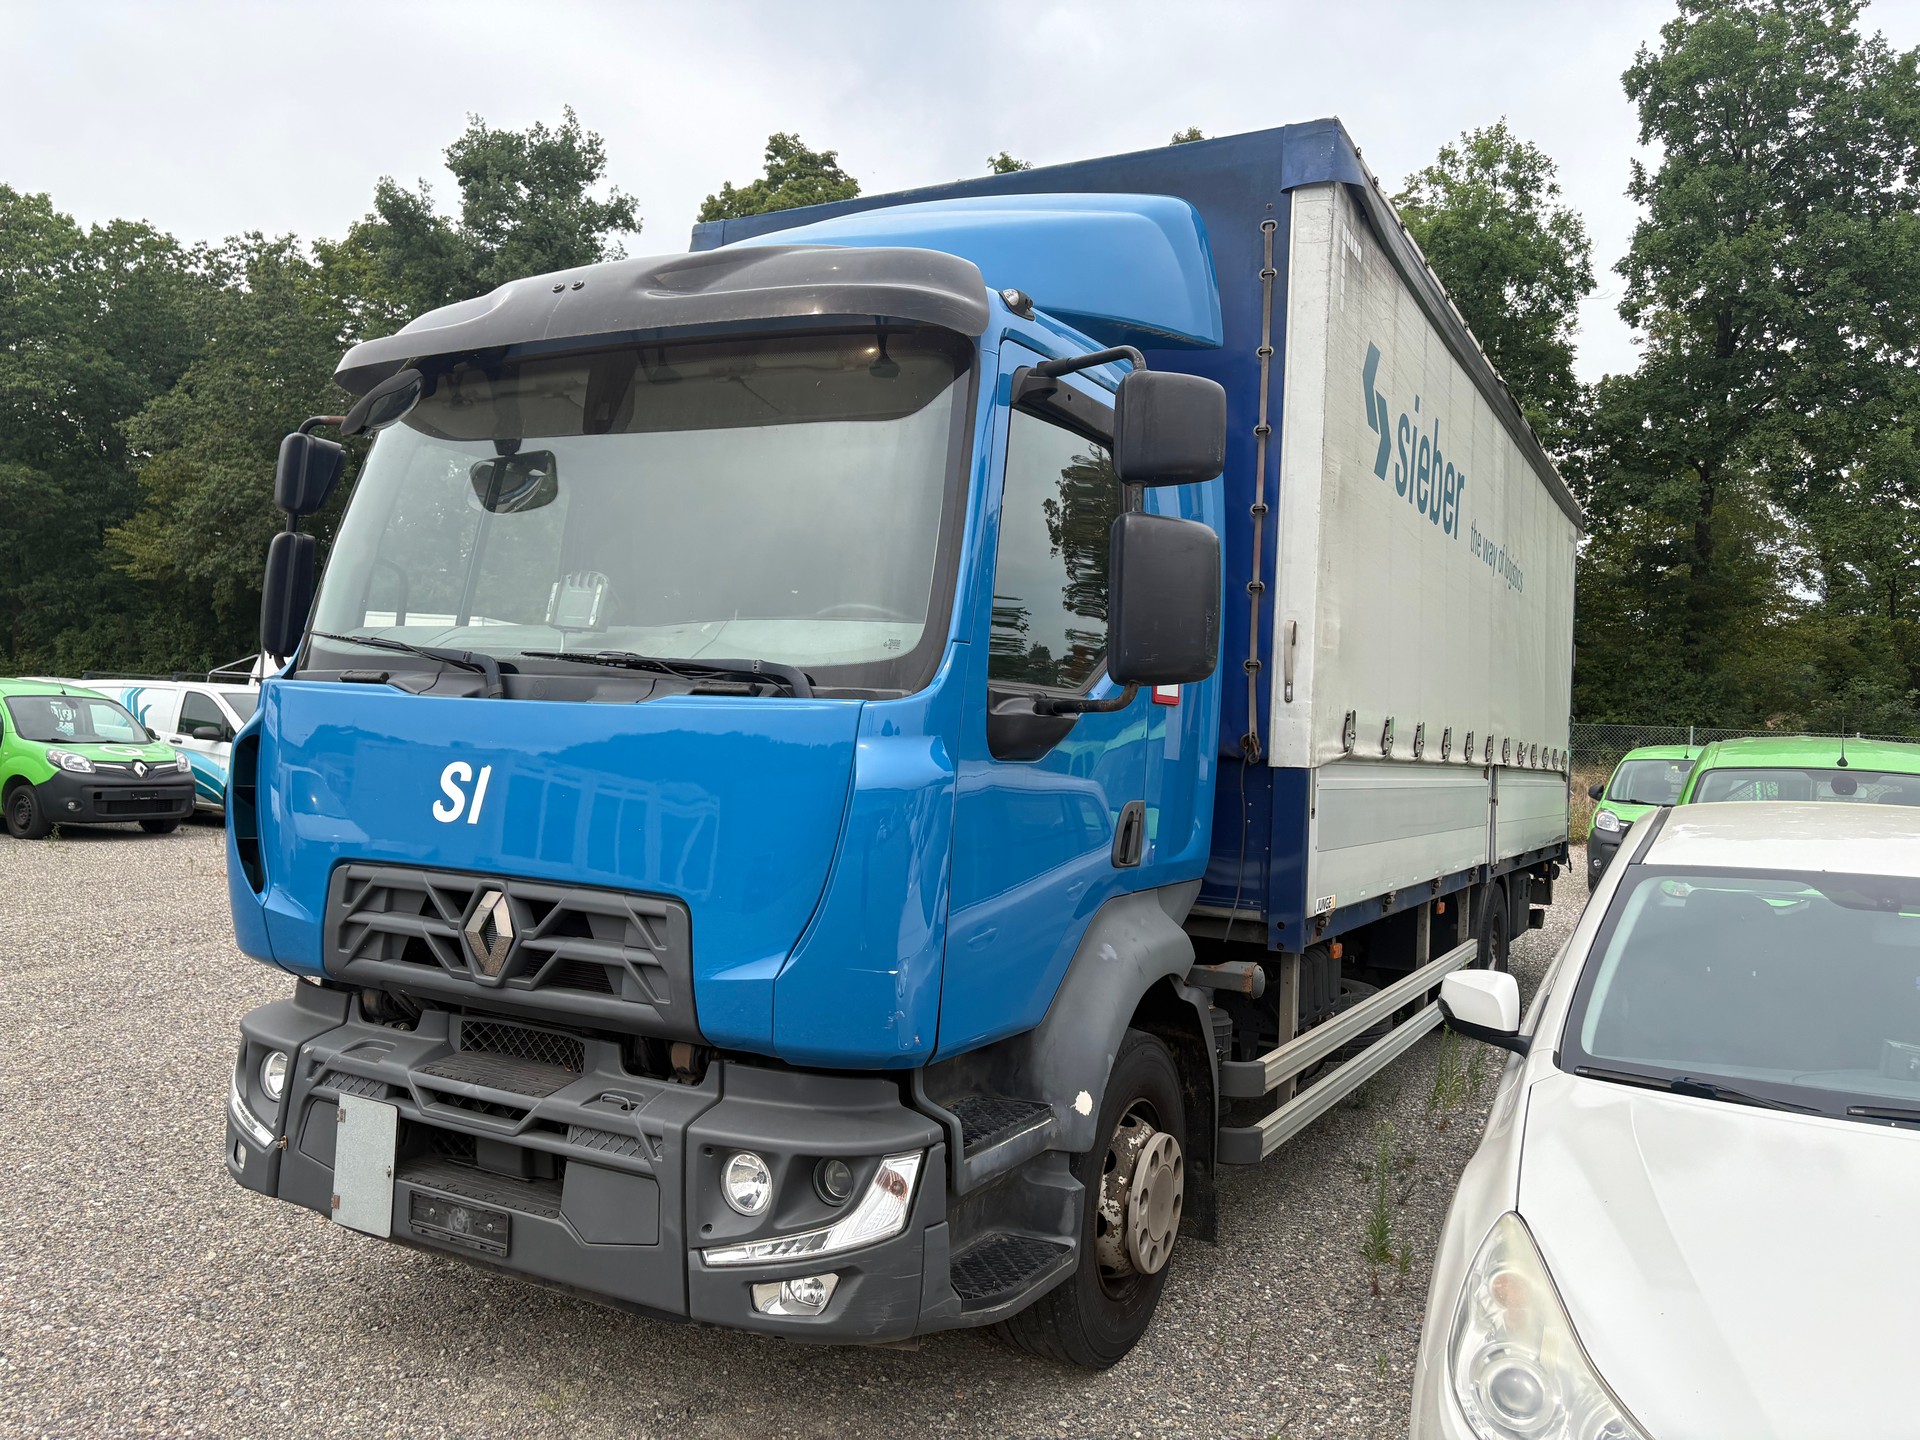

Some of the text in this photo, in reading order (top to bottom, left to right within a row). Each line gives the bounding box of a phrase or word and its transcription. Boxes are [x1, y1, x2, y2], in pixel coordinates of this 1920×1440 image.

[1395, 394, 1465, 540] sieber
[1470, 518, 1523, 593] the way of logistics
[432, 761, 492, 825] SI
